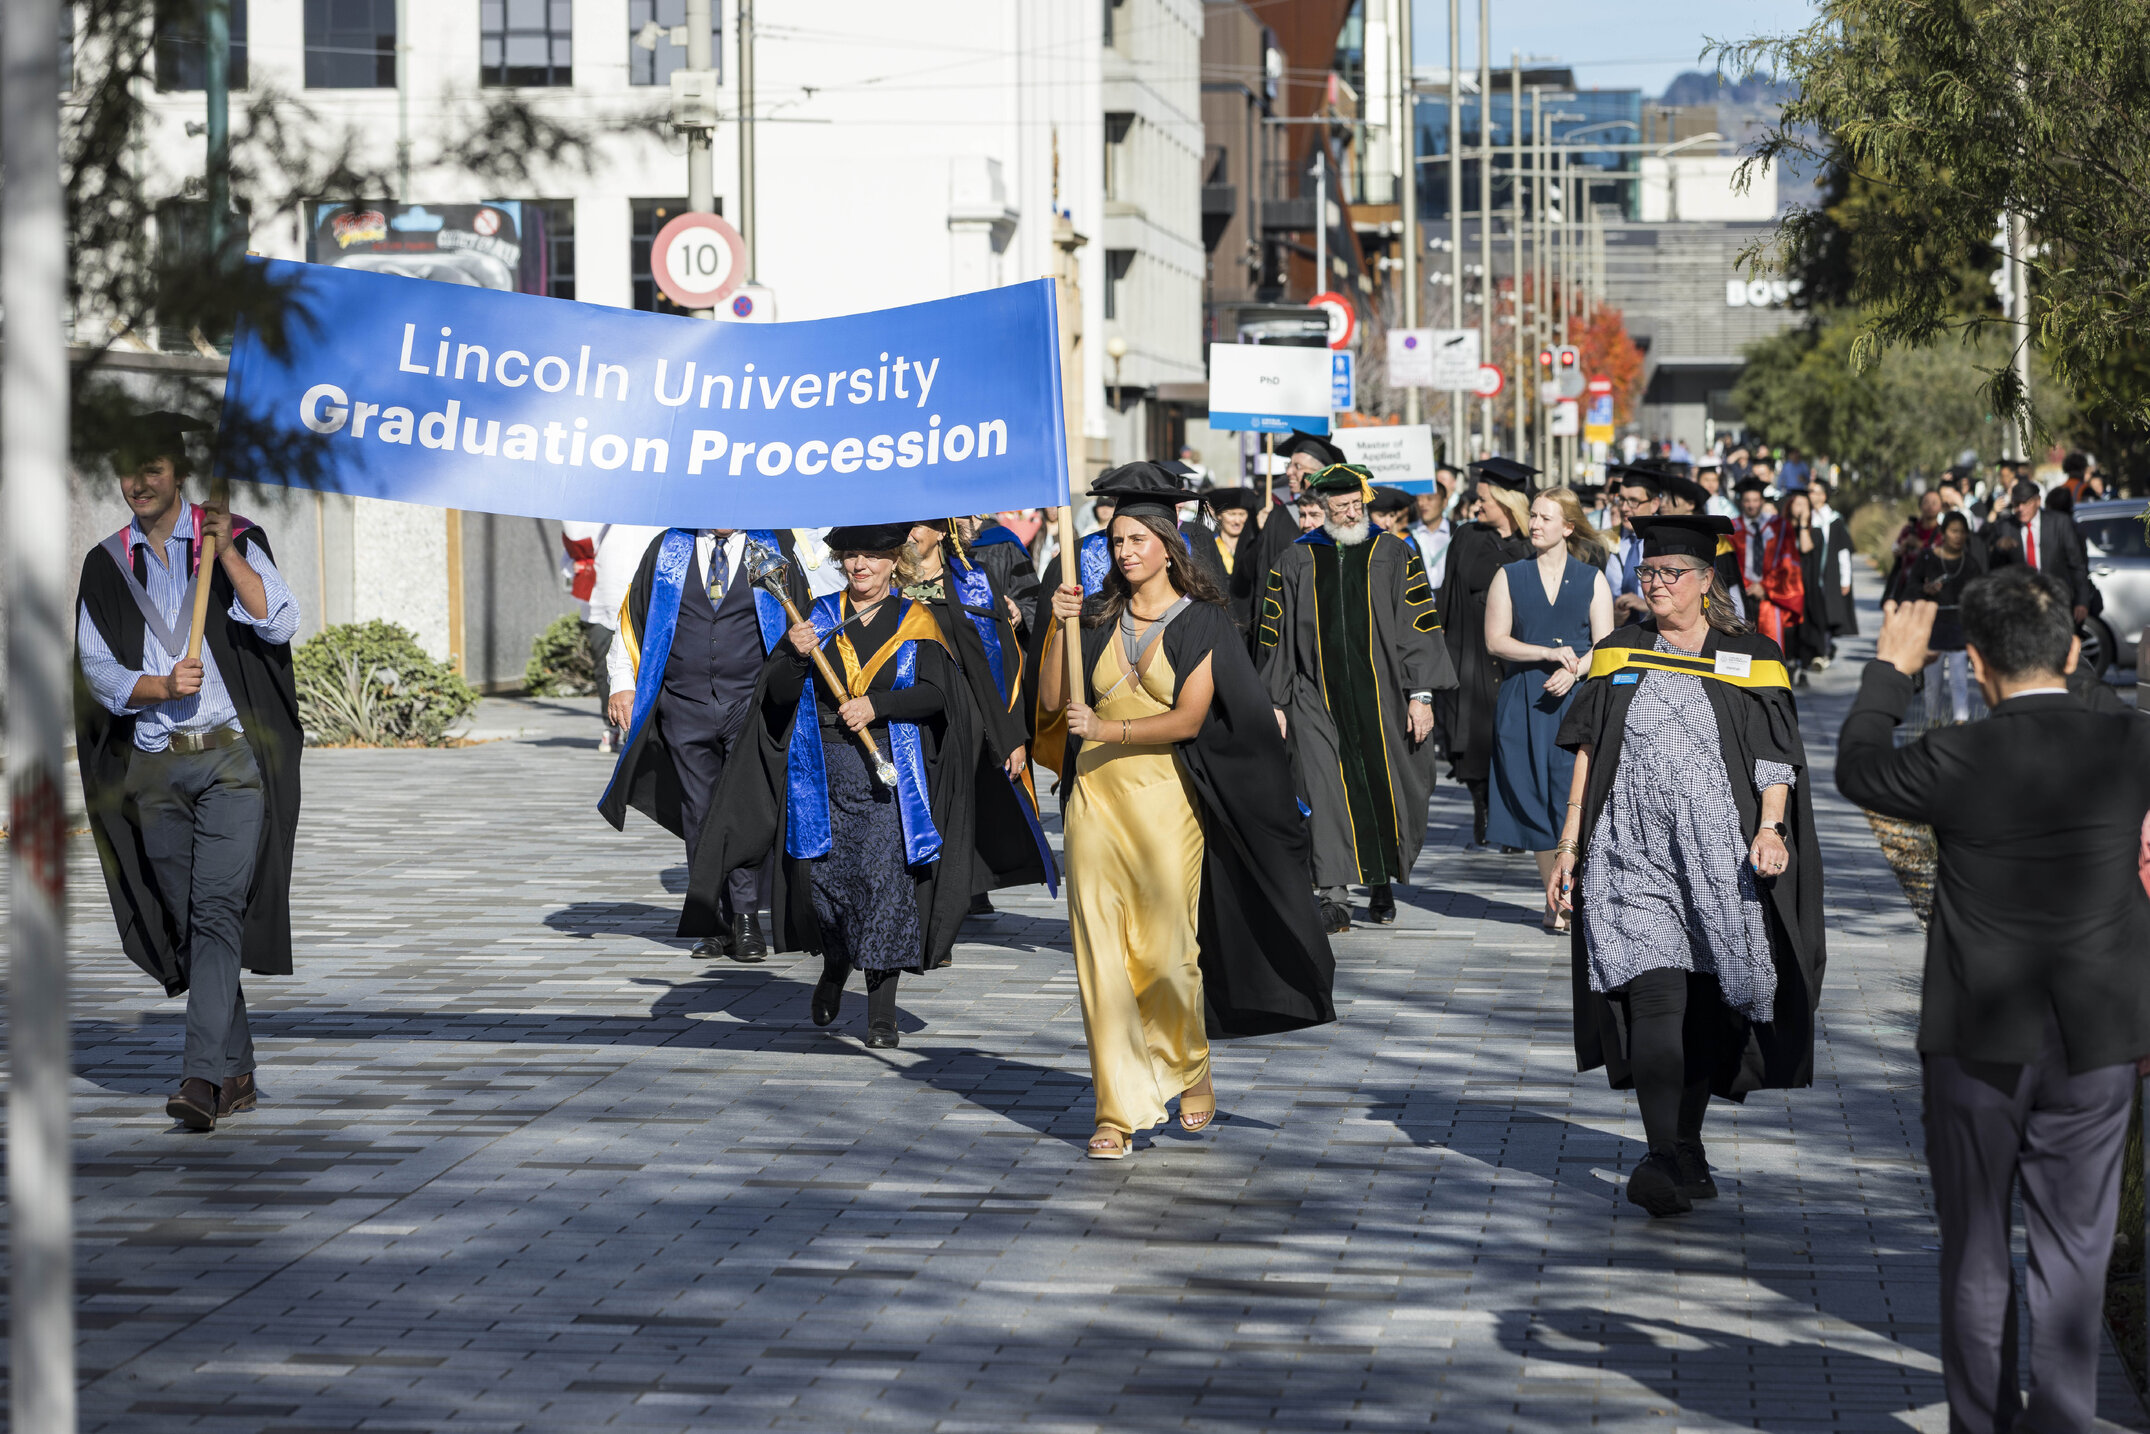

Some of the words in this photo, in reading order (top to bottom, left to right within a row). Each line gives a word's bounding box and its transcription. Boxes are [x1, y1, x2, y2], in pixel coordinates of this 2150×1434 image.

[682, 244, 718, 276] 10
[399, 323, 629, 402] Lincoln
[654, 352, 940, 409] University
[1259, 376, 1281, 386] PhD
[300, 384, 670, 473] Graduation
[687, 414, 1008, 477] Procession
[1356, 441, 1391, 450] Master
[1394, 439, 1404, 449] of
[1362, 451, 1401, 462] Applied
